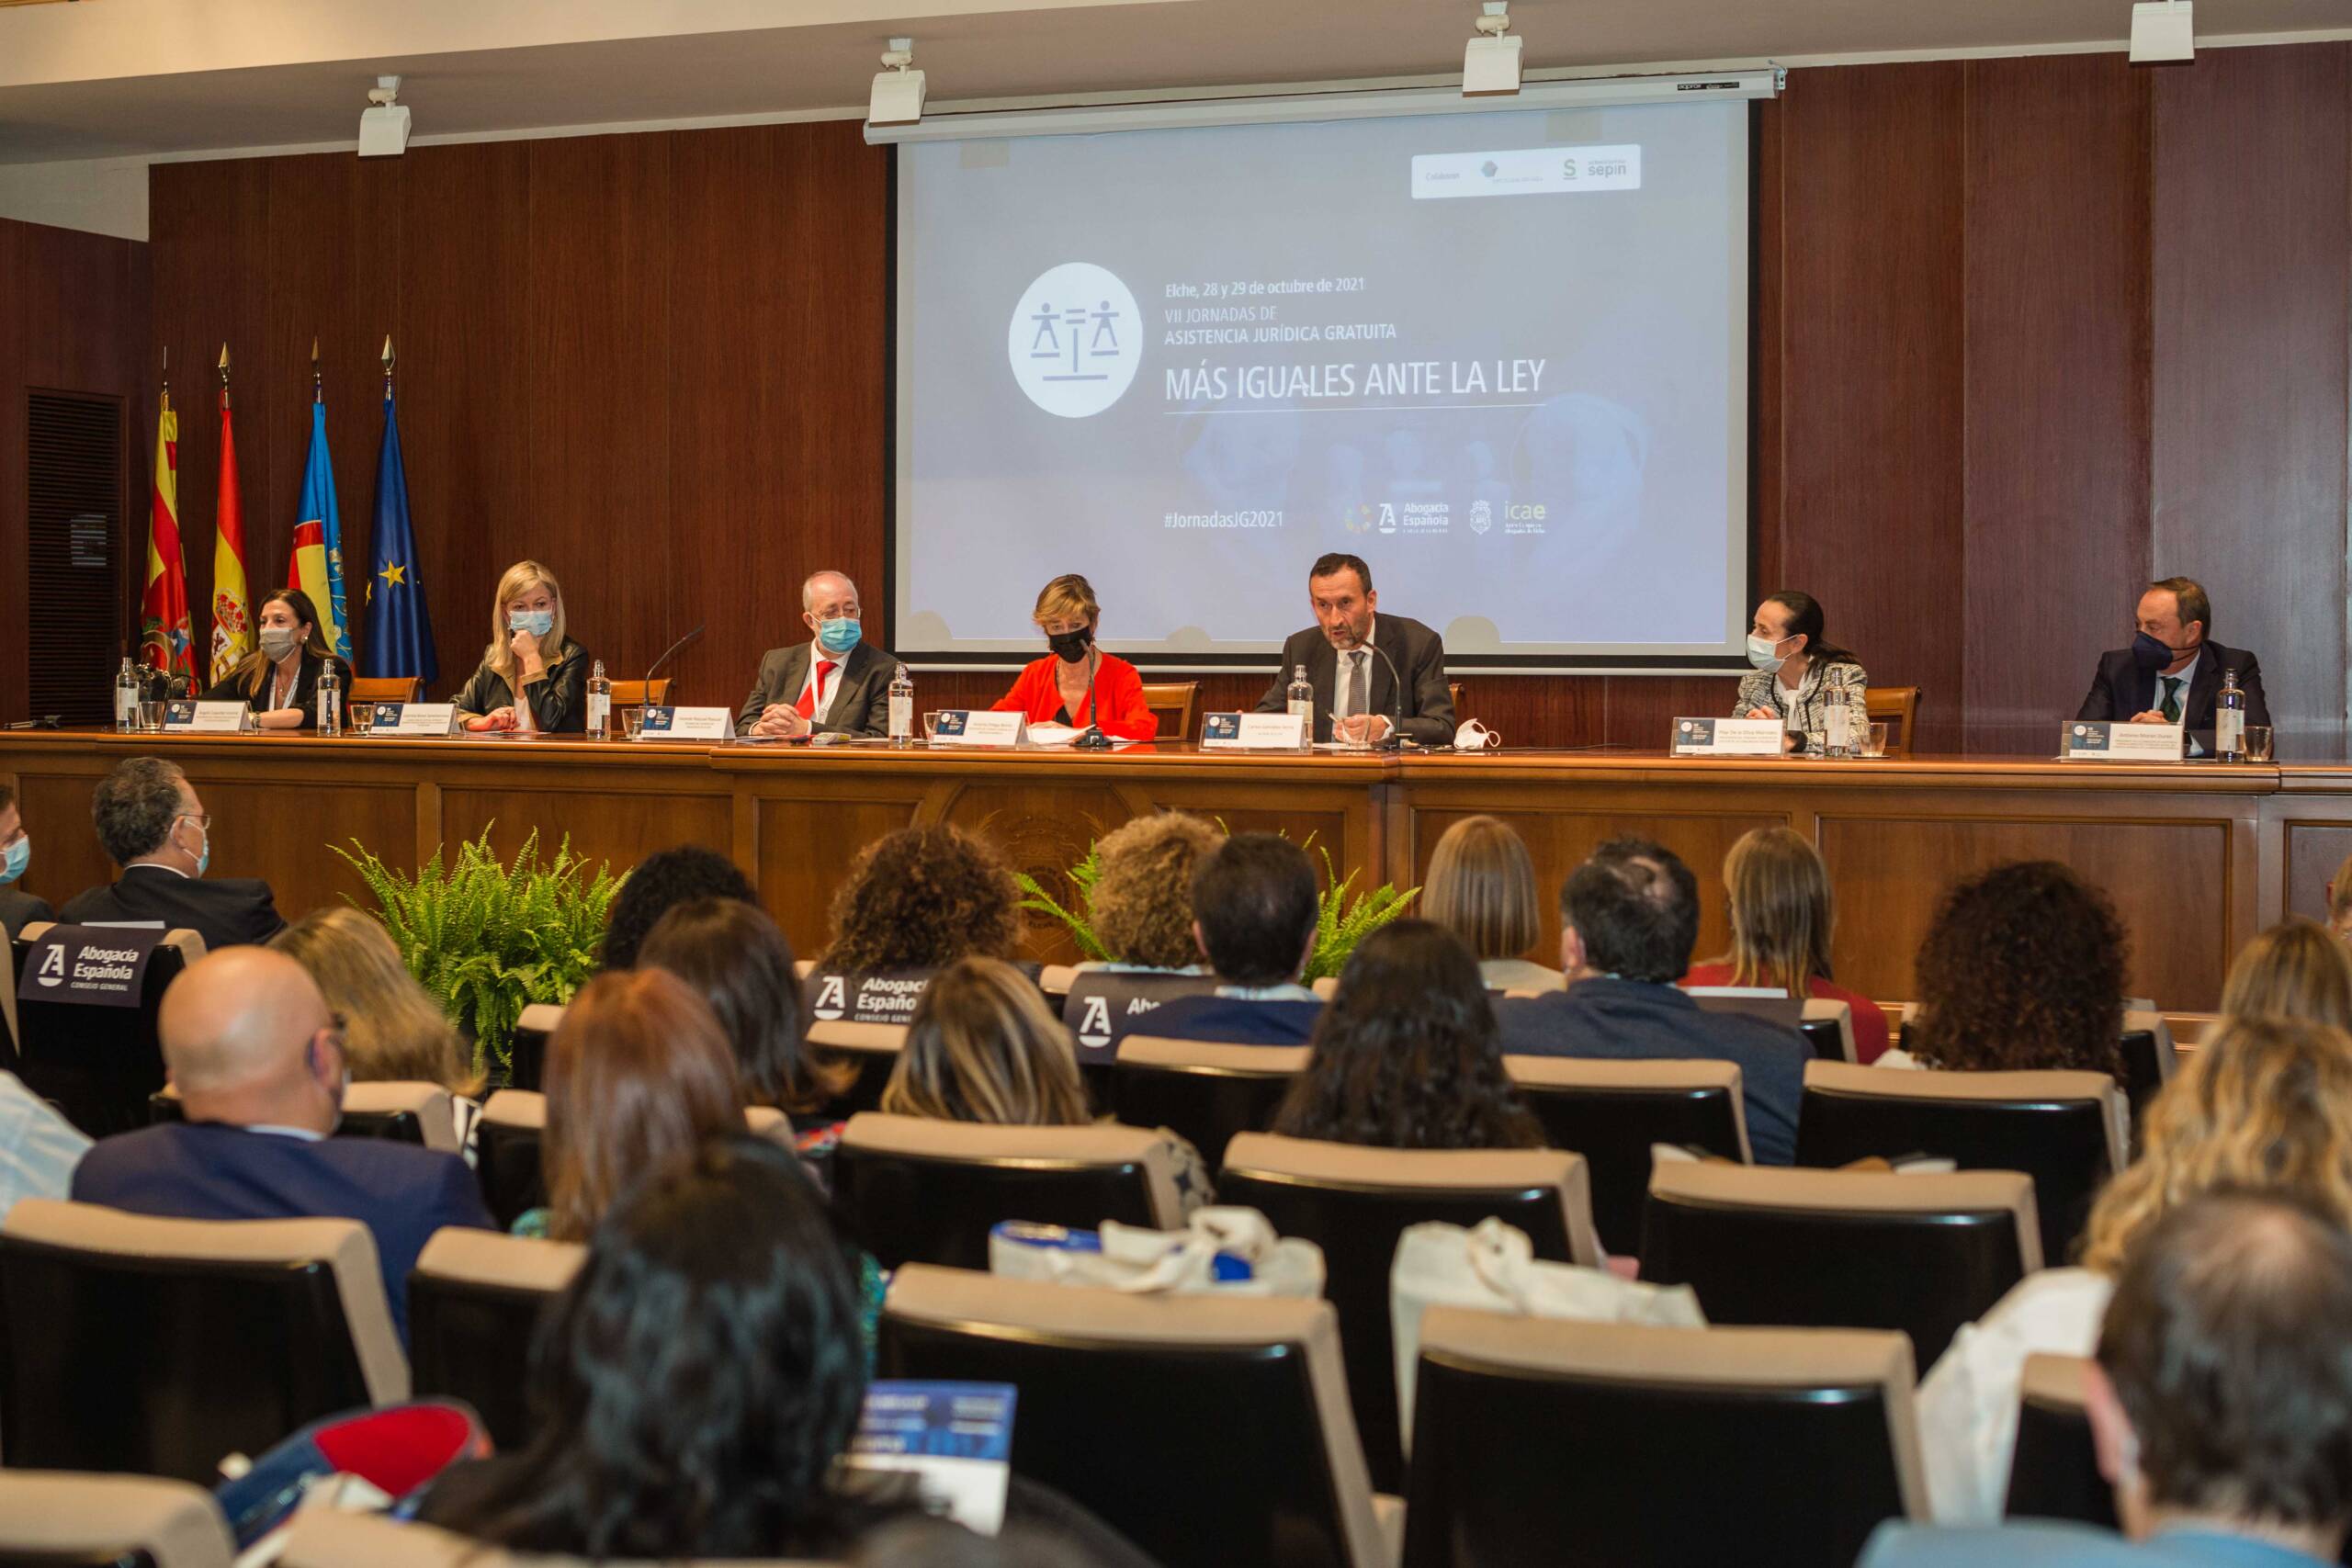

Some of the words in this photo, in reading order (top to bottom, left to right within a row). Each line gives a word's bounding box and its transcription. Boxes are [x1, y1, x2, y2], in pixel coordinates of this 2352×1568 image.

[1165, 283, 1200, 299] Elche,
[1203, 282, 1218, 296] 28
[1220, 284, 1228, 299] y
[1231, 281, 1247, 295] 29
[1249, 280, 1265, 294] de
[1267, 279, 1314, 294] octubre
[1317, 278, 1332, 292] de
[1335, 276, 1364, 292] 2021
[1164, 308, 1182, 323] VII
[1185, 307, 1257, 323] JORNADAS
[1260, 305, 1278, 321] DE
[1164, 327, 1249, 346] ASISTENCIA
[1252, 323, 1321, 344] JURÍDICA
[1324, 323, 1397, 341] GRATUITA
[1165, 359, 1228, 400] MÁS
[1238, 363, 1356, 399] IGUALES
[1363, 361, 1442, 396] ANTE
[1452, 360, 1487, 394] LA
[1498, 359, 1546, 393] LEY
[1403, 513, 1449, 527] Española
[1504, 501, 1546, 521] icae
[77, 945, 140, 964] Abogacía
[73, 963, 134, 981] Española
[861, 976, 928, 995] Abogac
[855, 993, 917, 1012] Españo
